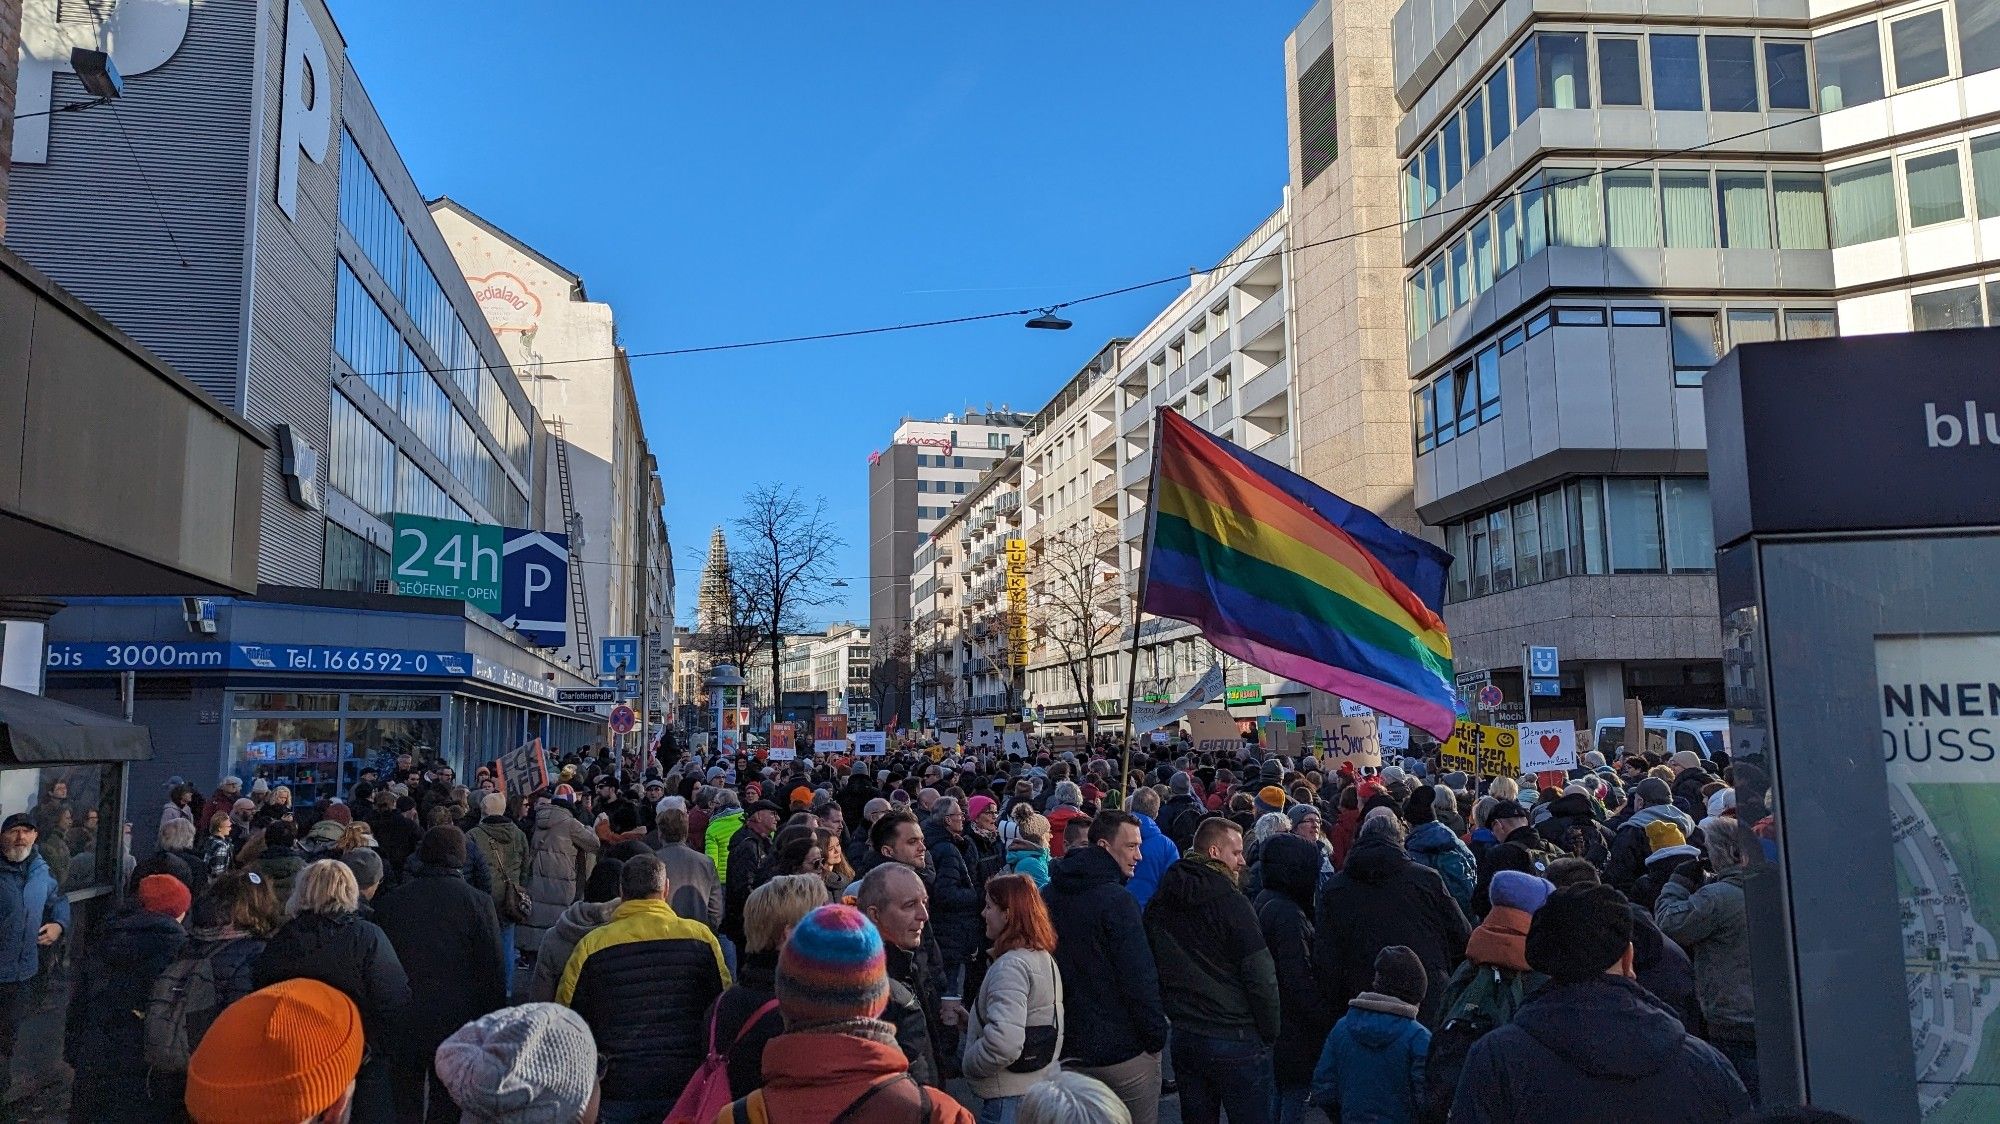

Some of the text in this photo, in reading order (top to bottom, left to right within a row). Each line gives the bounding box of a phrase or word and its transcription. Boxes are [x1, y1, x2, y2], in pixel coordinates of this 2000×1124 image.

[277, 0, 331, 222] P
[397, 528, 498, 583] 24h
[1011, 540, 1022, 600] LUCKY
[398, 580, 459, 598] GEÖFFNET
[467, 587, 498, 600] OPEN
[524, 562, 552, 608] P
[46, 644, 83, 666] bis
[105, 645, 222, 666] 3000mm
[286, 648, 317, 669] Tel.
[559, 690, 613, 702] Charlottenstraße
[1498, 711, 1524, 721] Mochi
[1322, 719, 1380, 758] #5vor33
